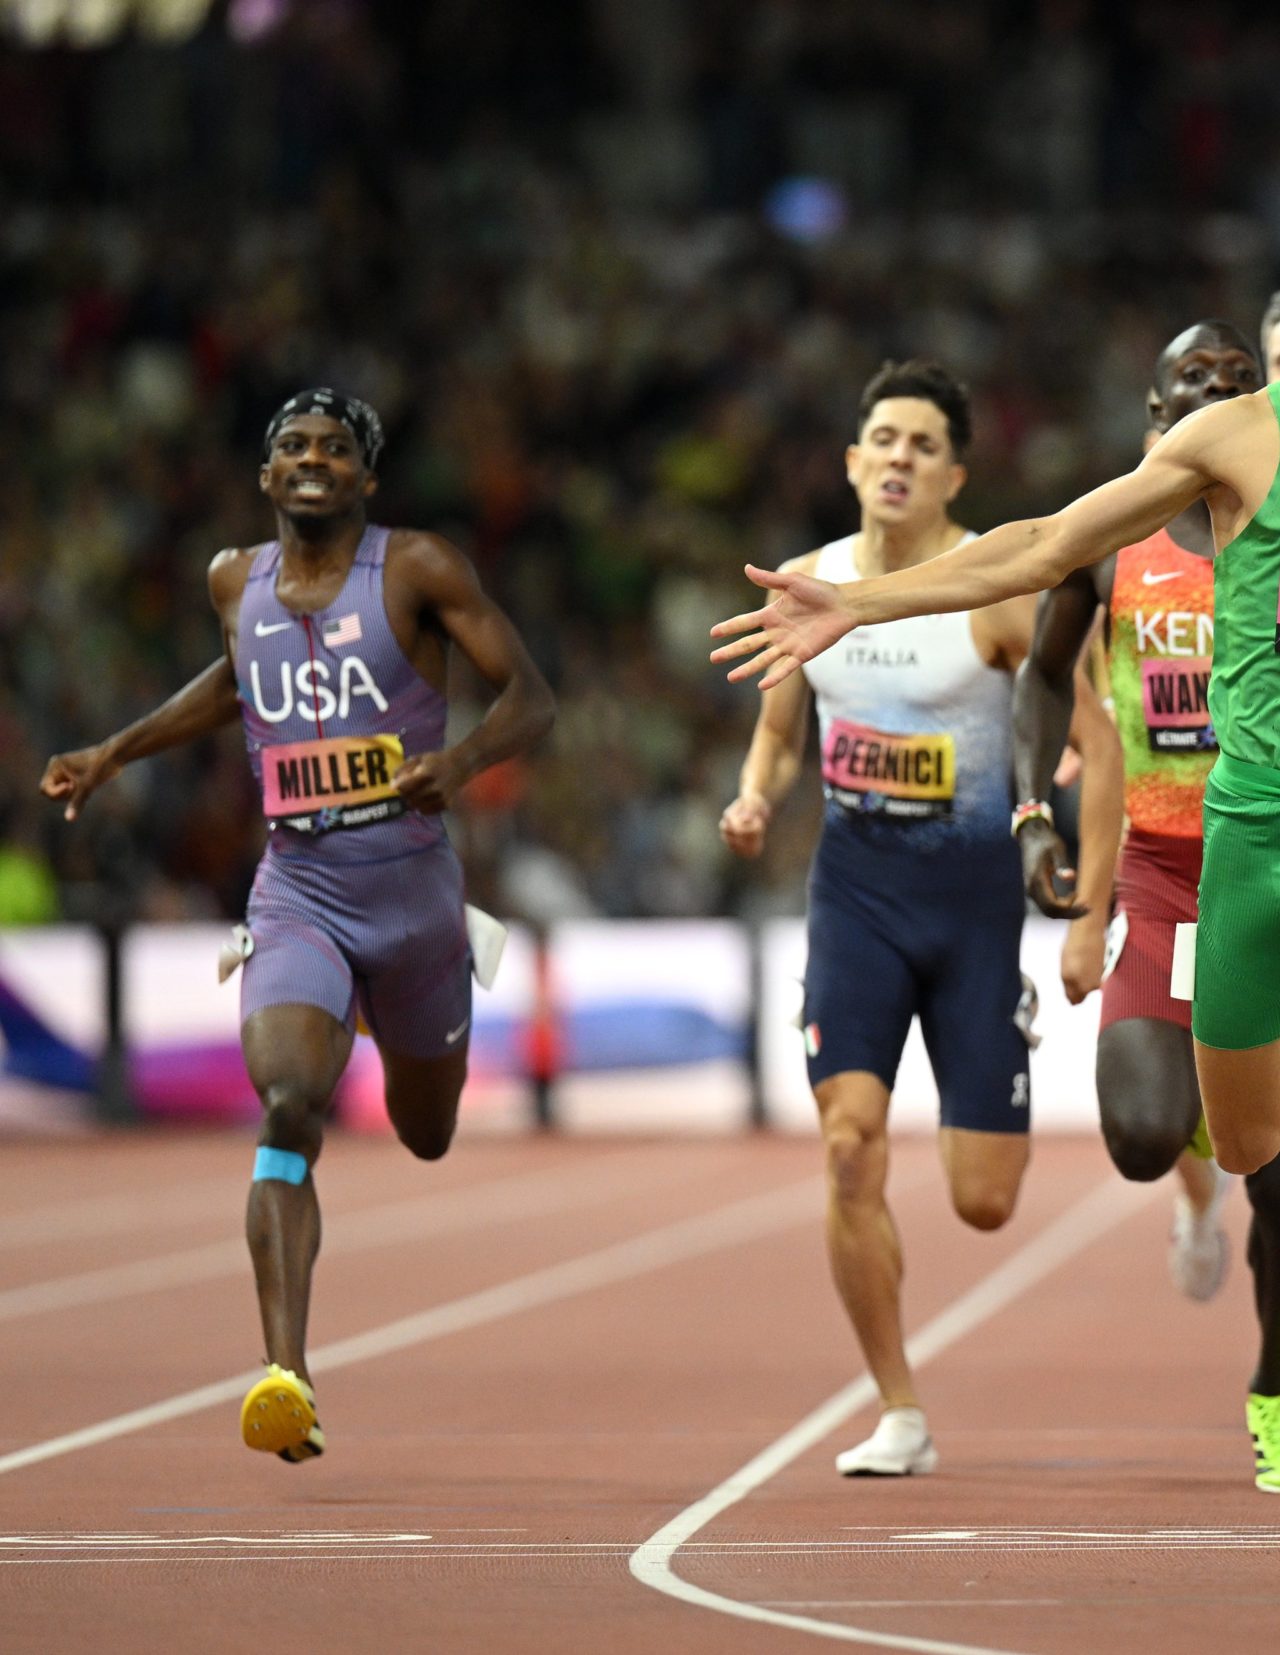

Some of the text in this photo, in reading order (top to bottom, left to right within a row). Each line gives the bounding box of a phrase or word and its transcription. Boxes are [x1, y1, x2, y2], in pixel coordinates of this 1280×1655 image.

[846, 648, 919, 667] ITALIA
[250, 656, 389, 722] USA
[277, 748, 389, 800] MILLER
[832, 735, 944, 786] PERNICI
